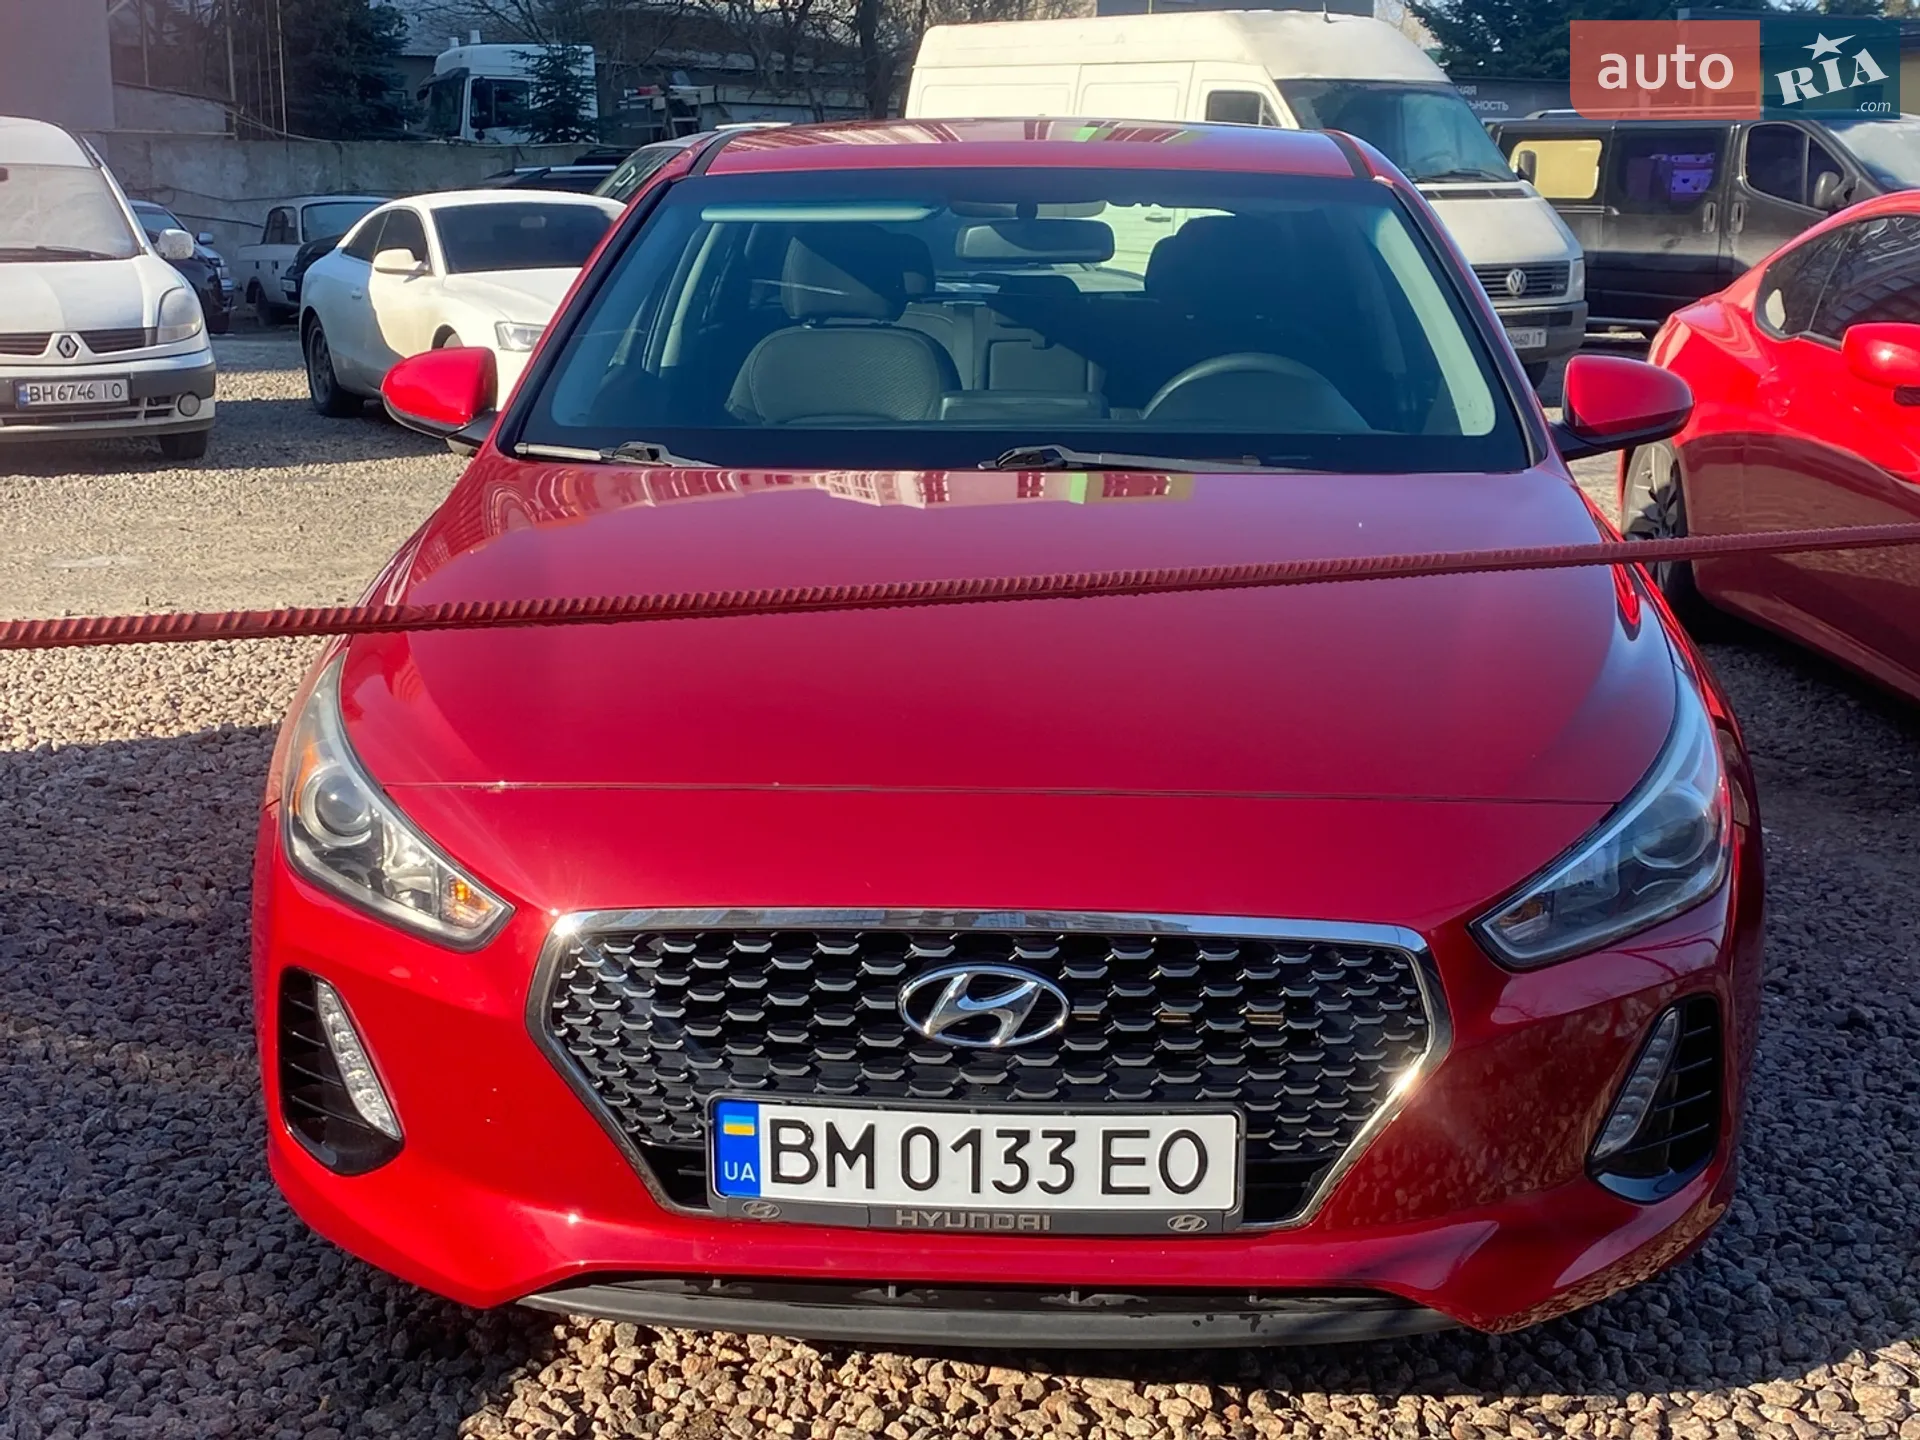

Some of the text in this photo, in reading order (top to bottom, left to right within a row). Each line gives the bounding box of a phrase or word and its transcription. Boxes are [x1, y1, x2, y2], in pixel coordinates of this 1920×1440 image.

[769, 1118, 1208, 1195] BM 0133 EO
[724, 1161, 756, 1182] UA
[895, 1208, 1050, 1231] HYUNDAI
